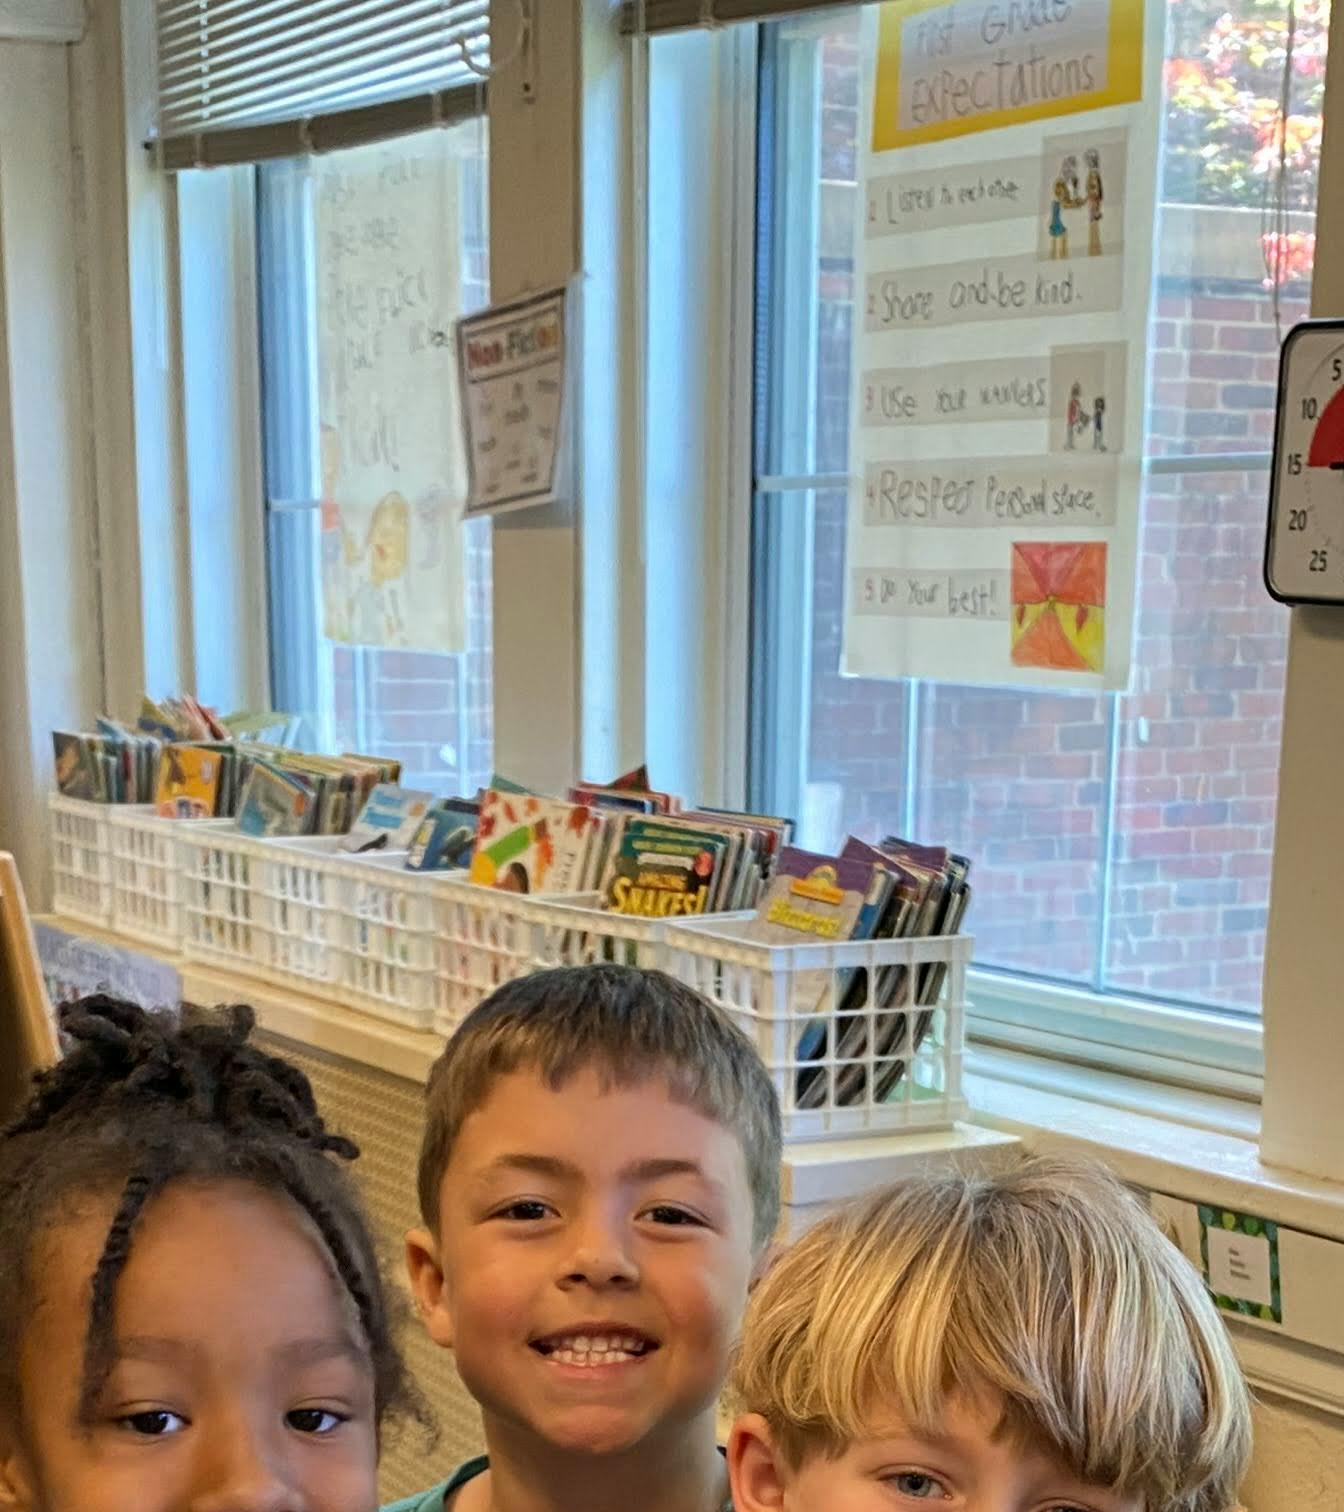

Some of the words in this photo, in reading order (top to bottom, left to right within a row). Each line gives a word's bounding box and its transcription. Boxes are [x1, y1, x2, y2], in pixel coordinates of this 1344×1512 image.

[1331, 359, 1342, 382] 5
[1301, 397, 1318, 420] 10
[1287, 453, 1302, 476] 15
[1288, 509, 1307, 531] 20
[1309, 550, 1328, 572] 25
